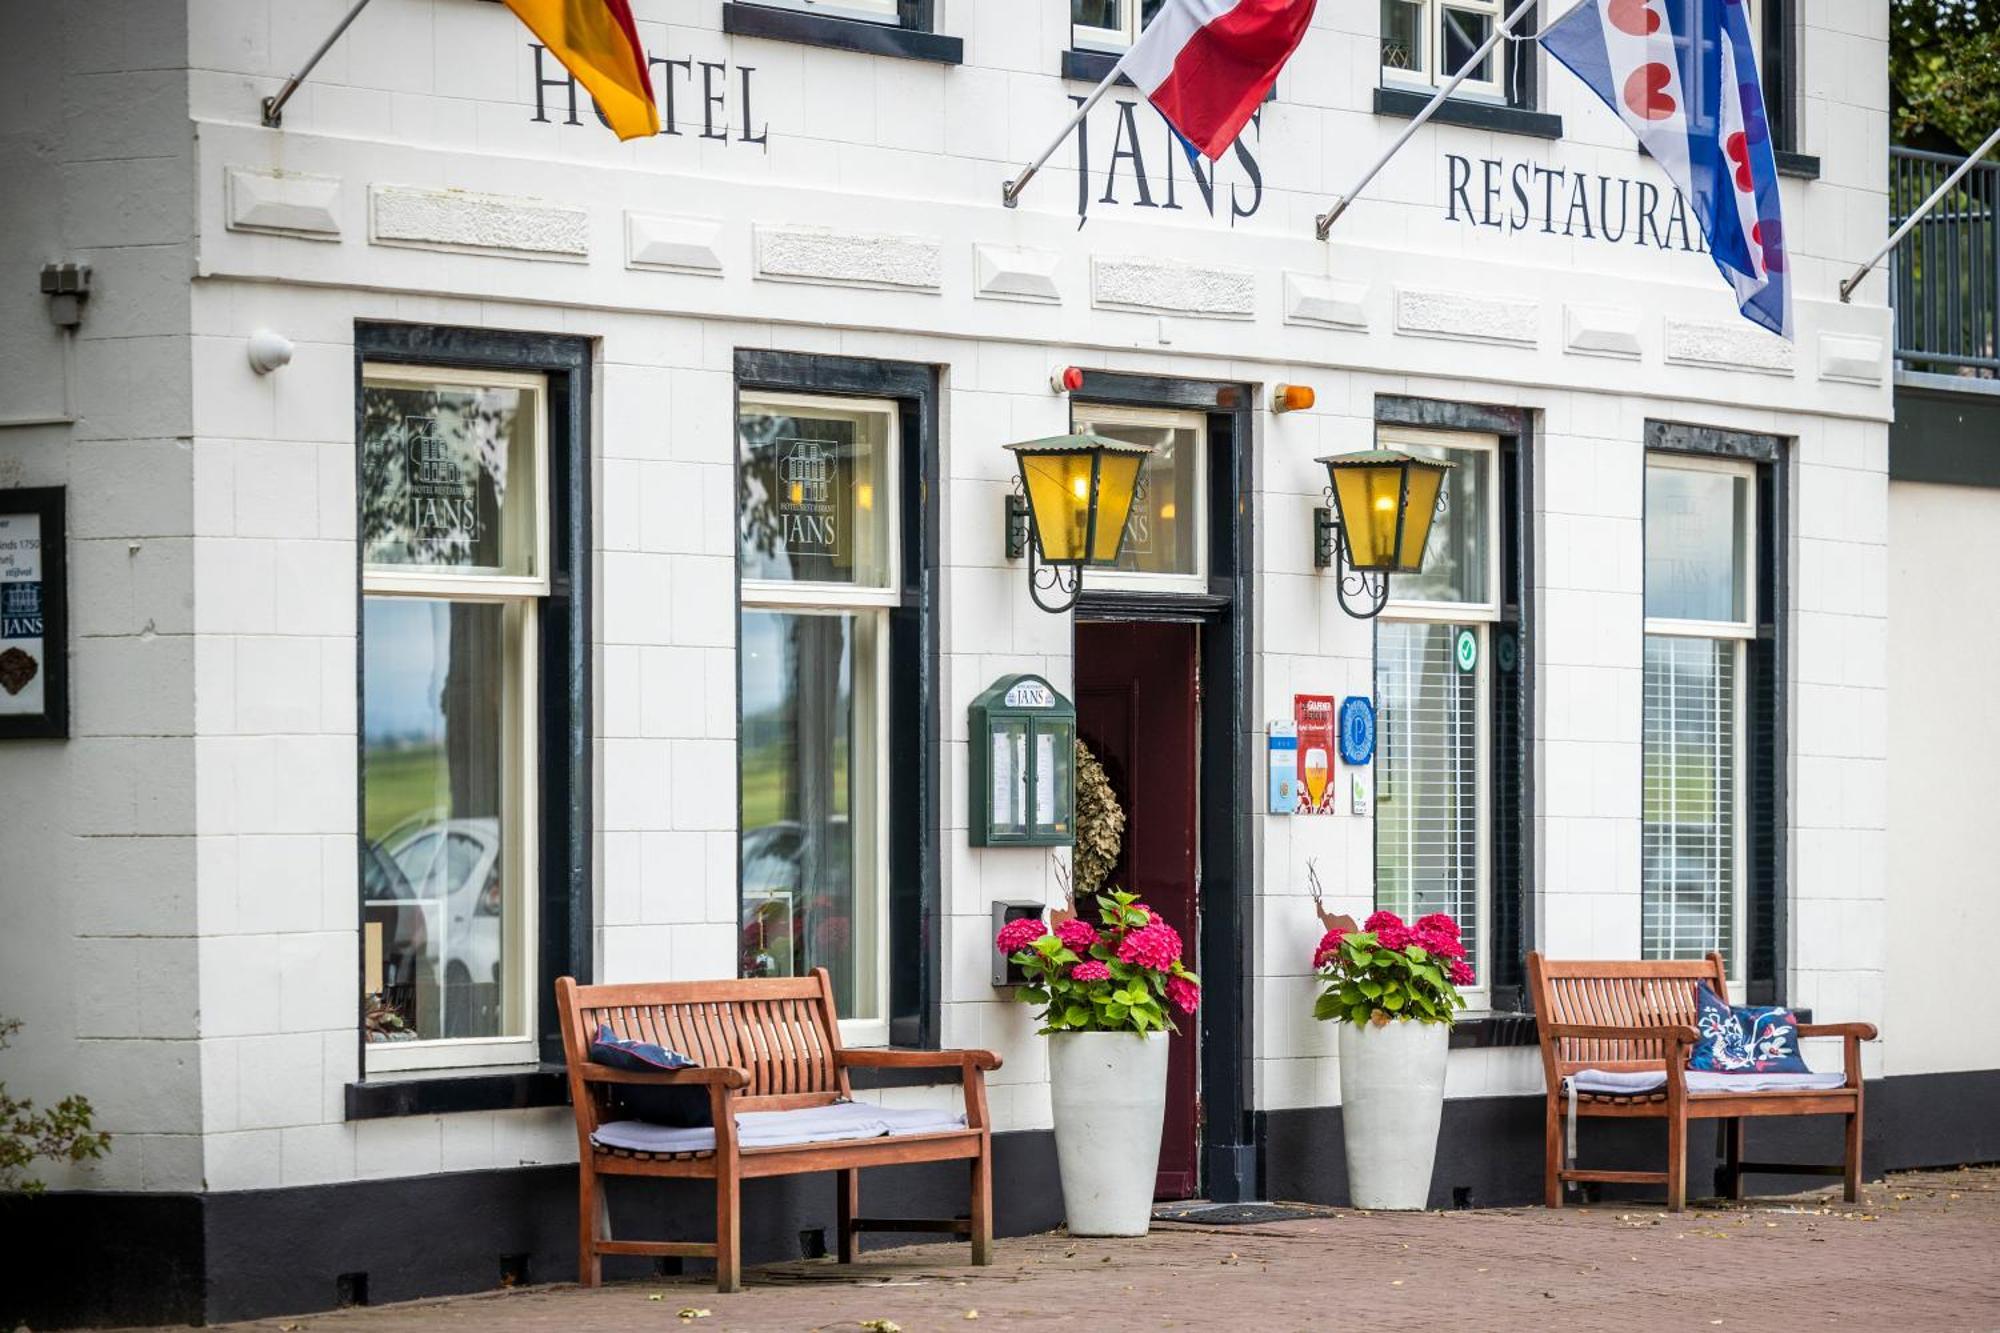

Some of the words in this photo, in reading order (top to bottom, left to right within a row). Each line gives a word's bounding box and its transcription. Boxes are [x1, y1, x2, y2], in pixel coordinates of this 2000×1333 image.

[528, 44, 768, 154] HTEL
[412, 498, 475, 535] JANS
[781, 514, 836, 547] JANS
[1123, 515, 1150, 542] NS
[4, 618, 44, 637] JANS
[1016, 690, 1044, 705] JANS
